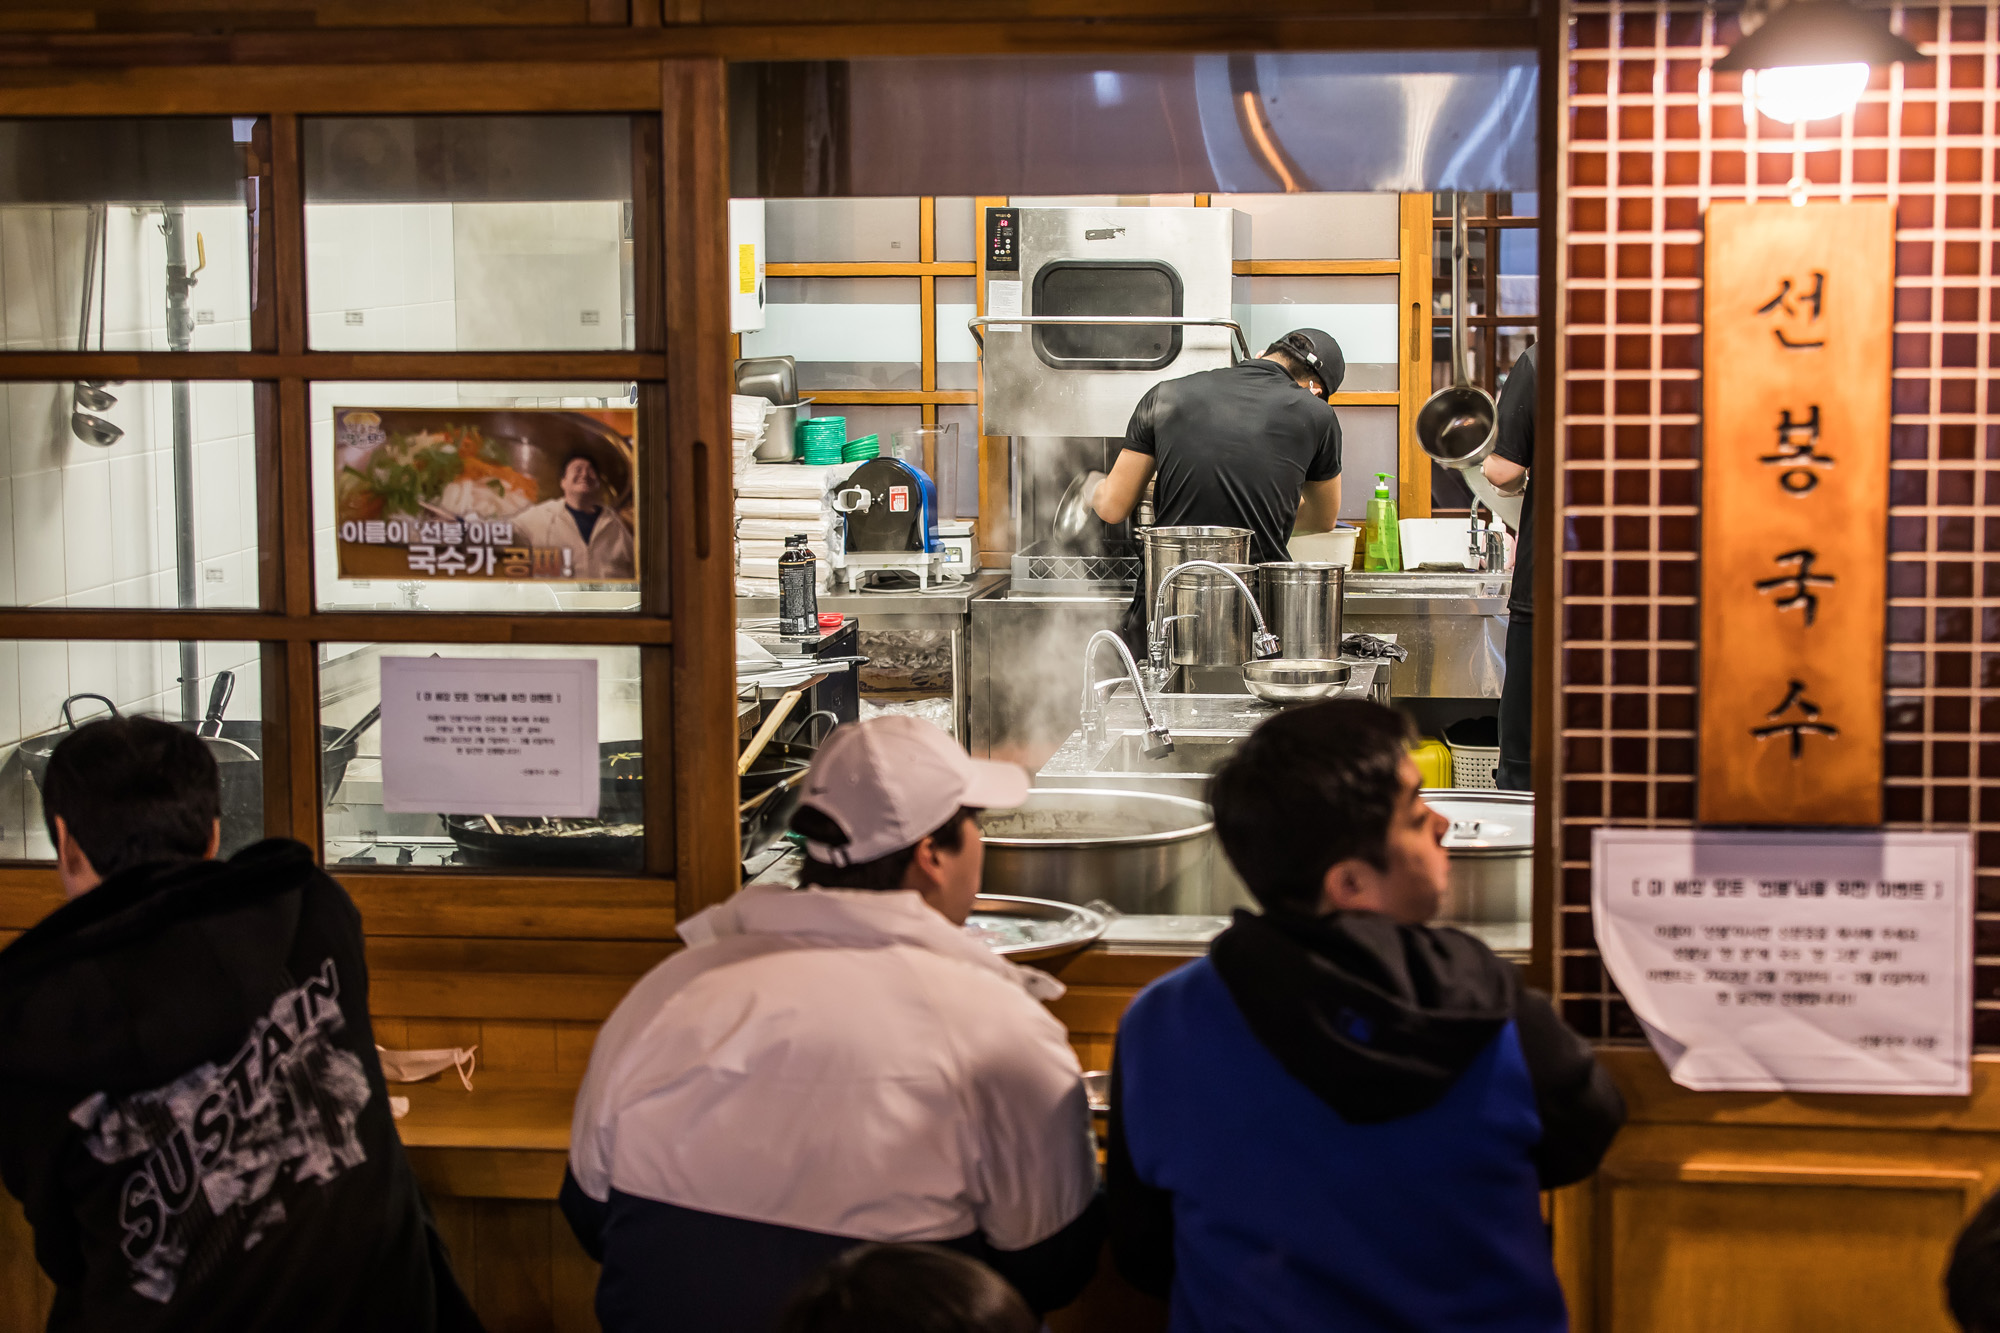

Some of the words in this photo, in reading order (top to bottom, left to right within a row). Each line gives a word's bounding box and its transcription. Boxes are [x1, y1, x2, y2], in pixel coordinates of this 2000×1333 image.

[343, 521, 409, 543] 이름이
[408, 545, 497, 577] 국수가
[1750, 272, 1839, 761] 선봉국수
[118, 956, 341, 1263] SUSTAIN
